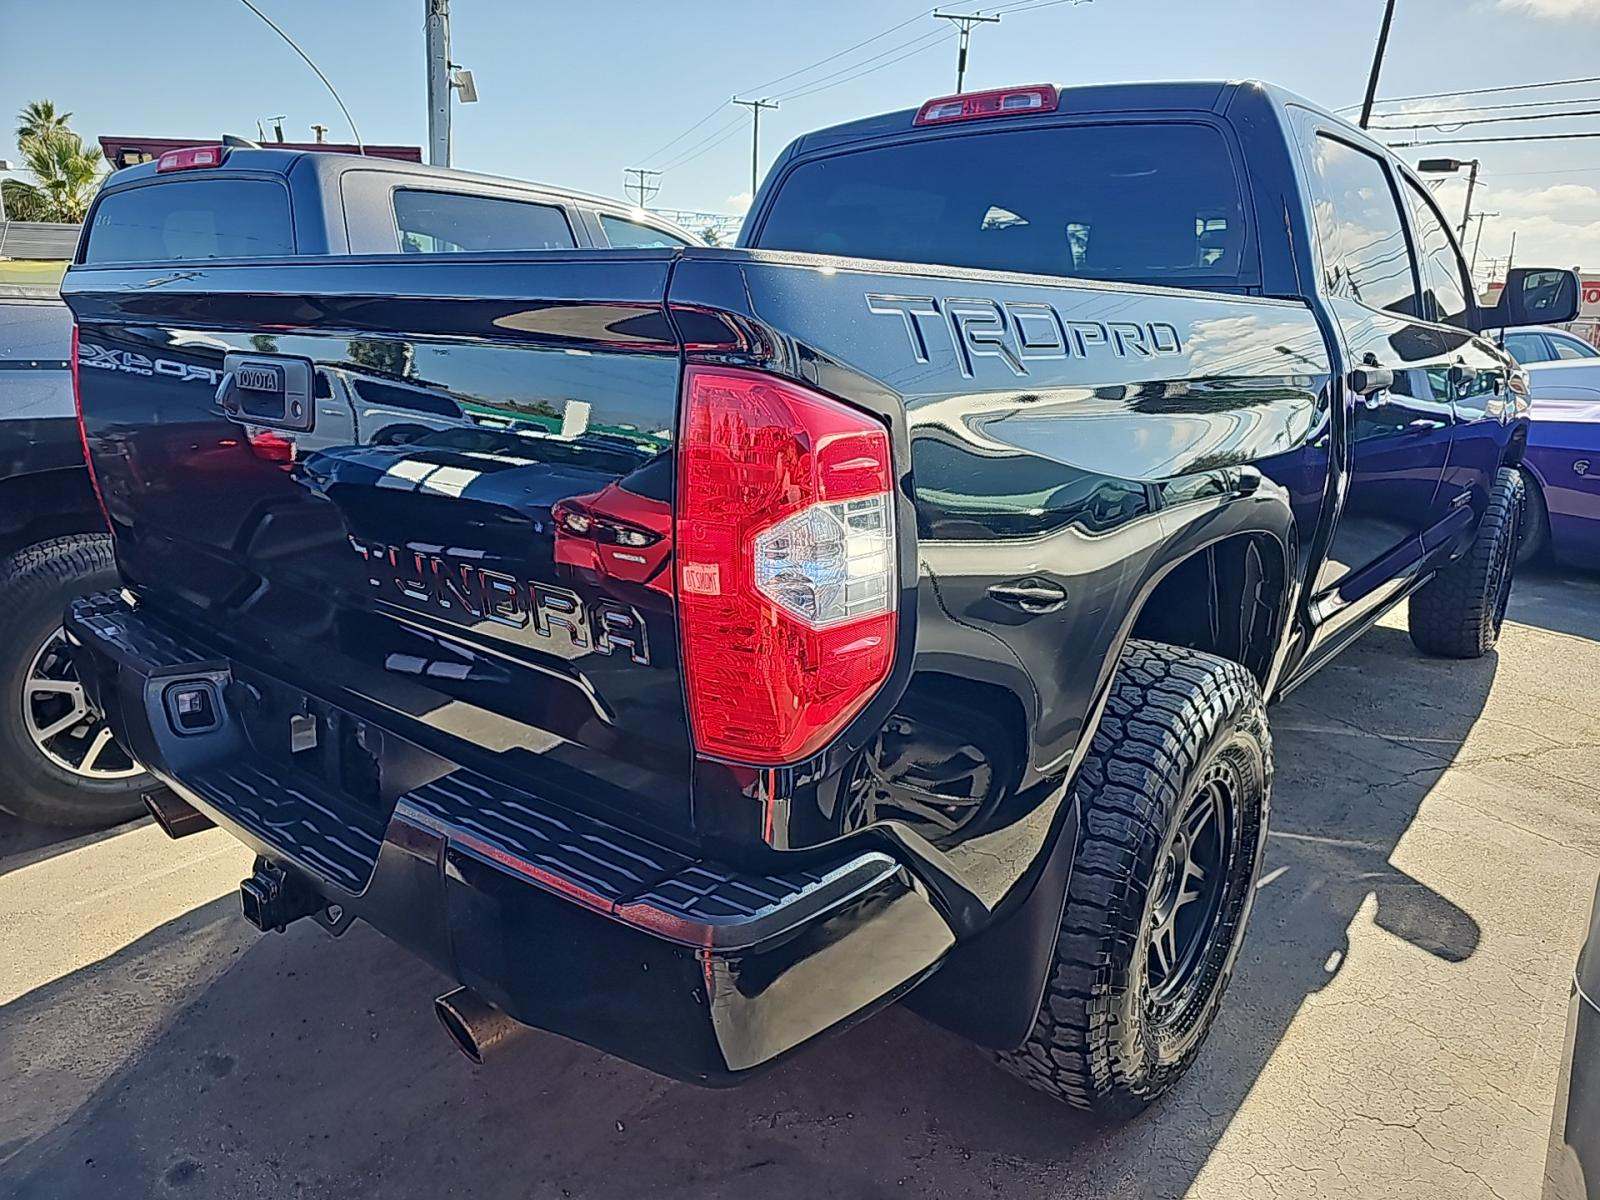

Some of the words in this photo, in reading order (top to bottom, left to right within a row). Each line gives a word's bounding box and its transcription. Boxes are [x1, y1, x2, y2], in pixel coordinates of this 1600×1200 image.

[864, 292, 1070, 379] TRD
[1066, 320, 1182, 360] PRO
[237, 370, 277, 391] TOYOTA
[347, 533, 650, 666] TUNDRA
